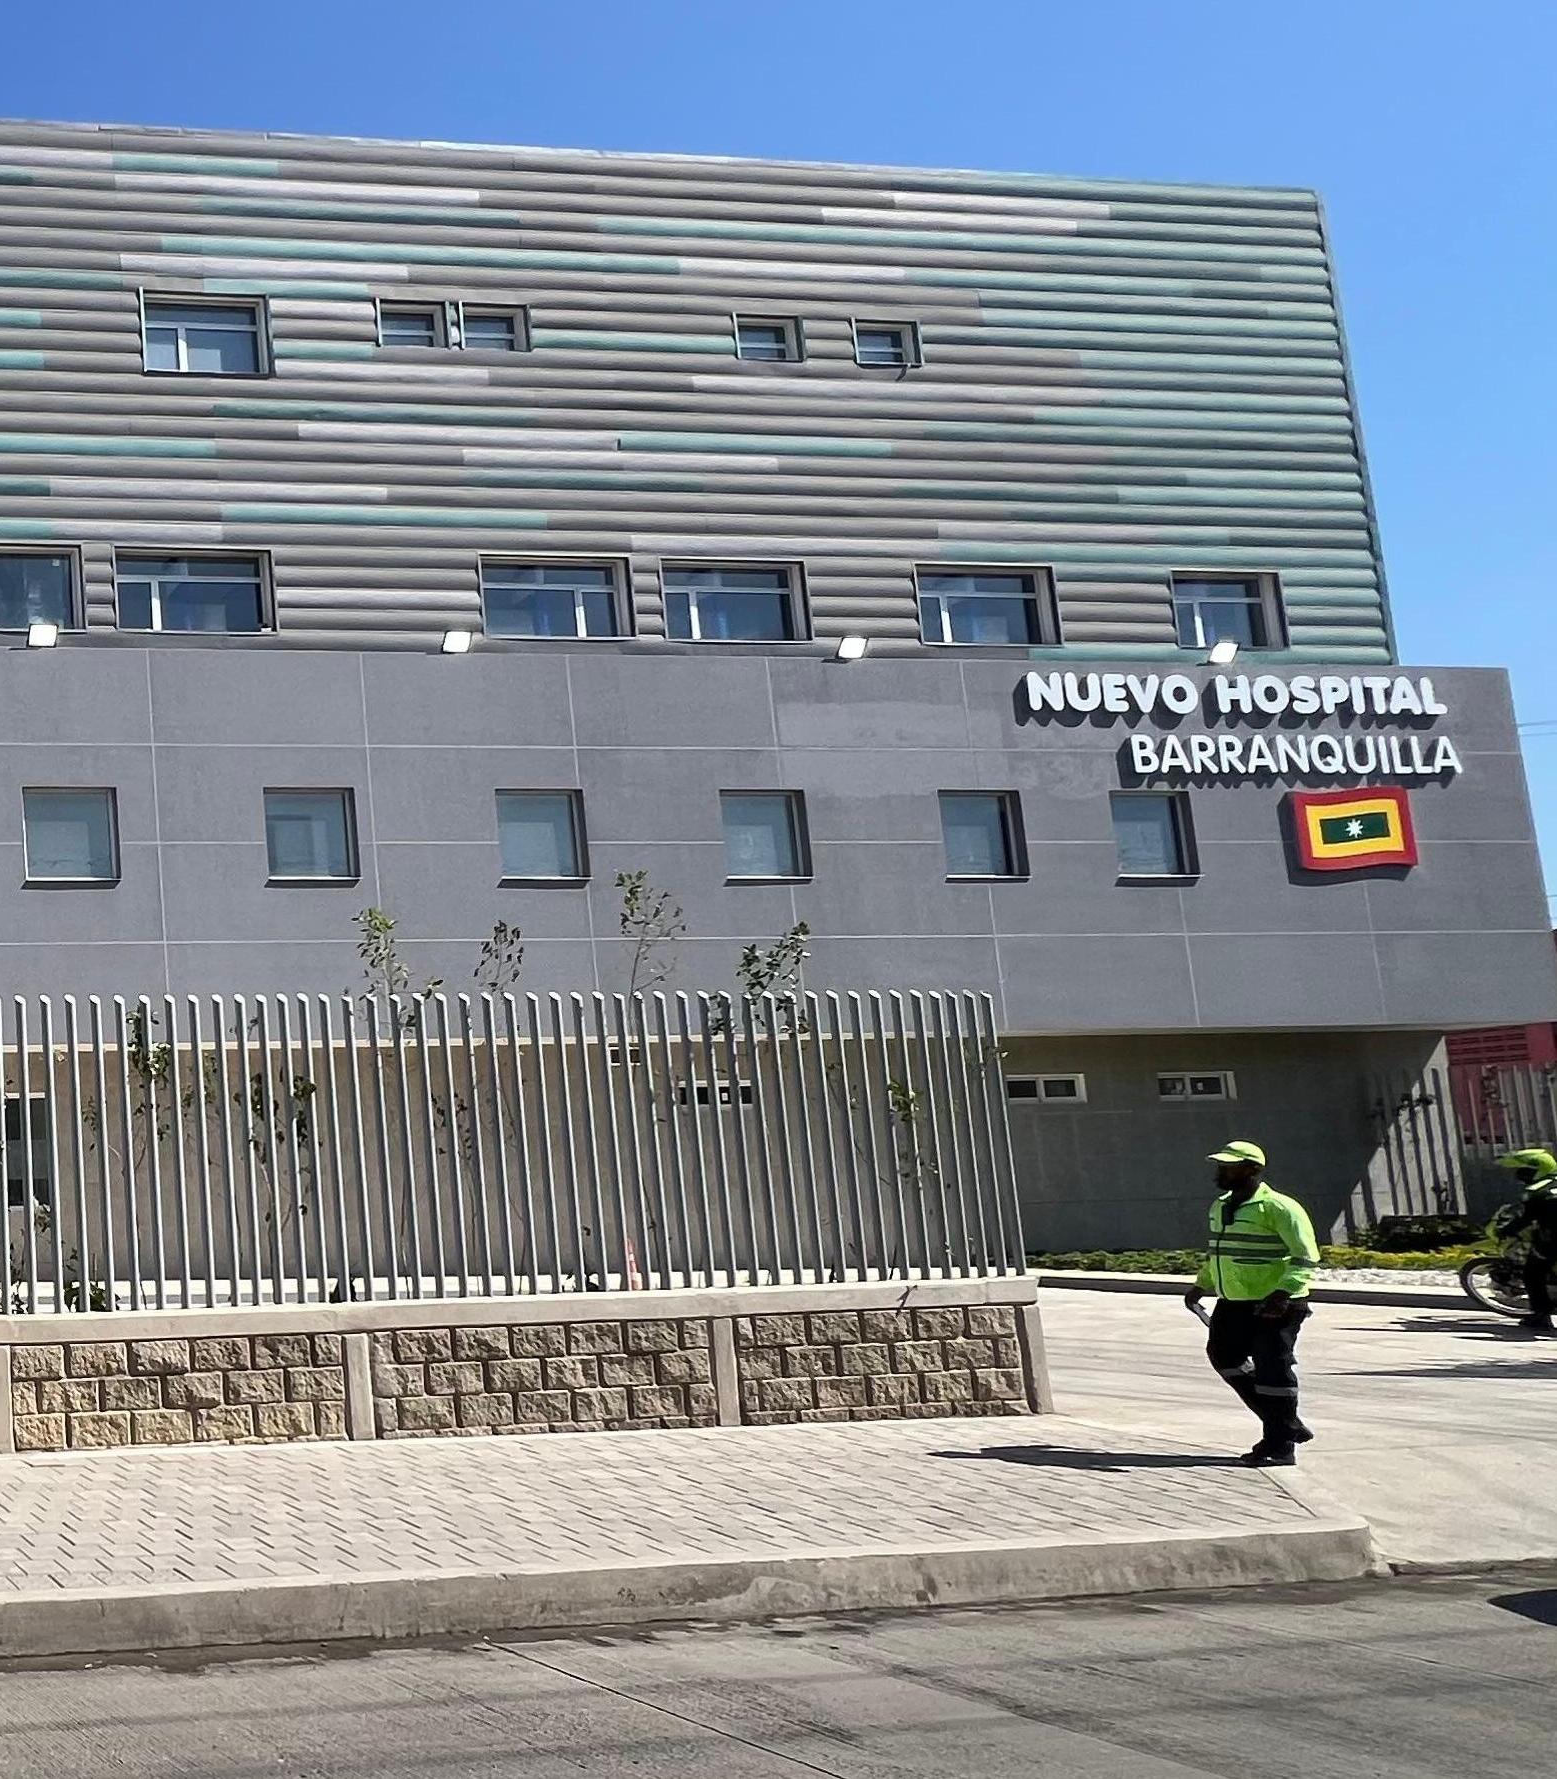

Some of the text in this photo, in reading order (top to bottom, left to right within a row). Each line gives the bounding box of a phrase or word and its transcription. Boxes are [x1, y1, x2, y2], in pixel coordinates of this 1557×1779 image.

[1026, 671, 1449, 716] NUEVO HOSPITAL
[1131, 733, 1463, 775] BARRANQUILLA
